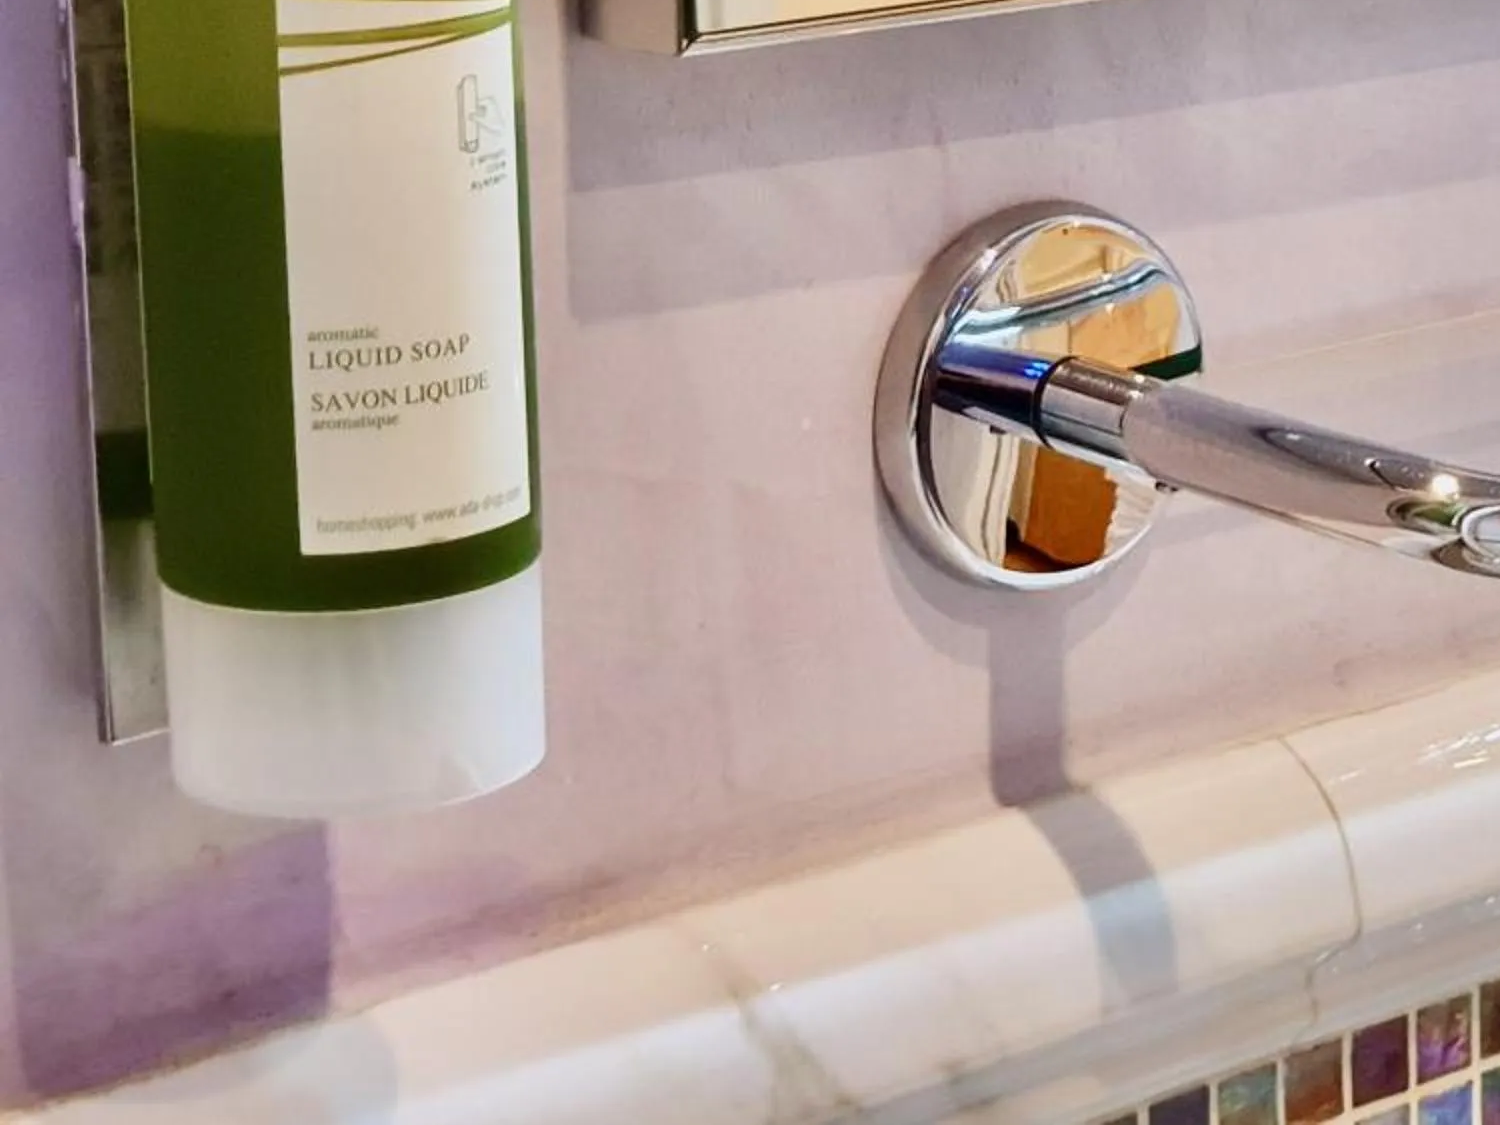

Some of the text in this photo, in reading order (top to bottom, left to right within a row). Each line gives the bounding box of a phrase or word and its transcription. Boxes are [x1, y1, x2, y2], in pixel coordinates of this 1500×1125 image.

[307, 325, 379, 342] aromatic
[309, 333, 470, 372] LIQUID SOAP
[311, 370, 490, 414] SAVON LIQUIDE
[312, 413, 399, 432] aromatique
